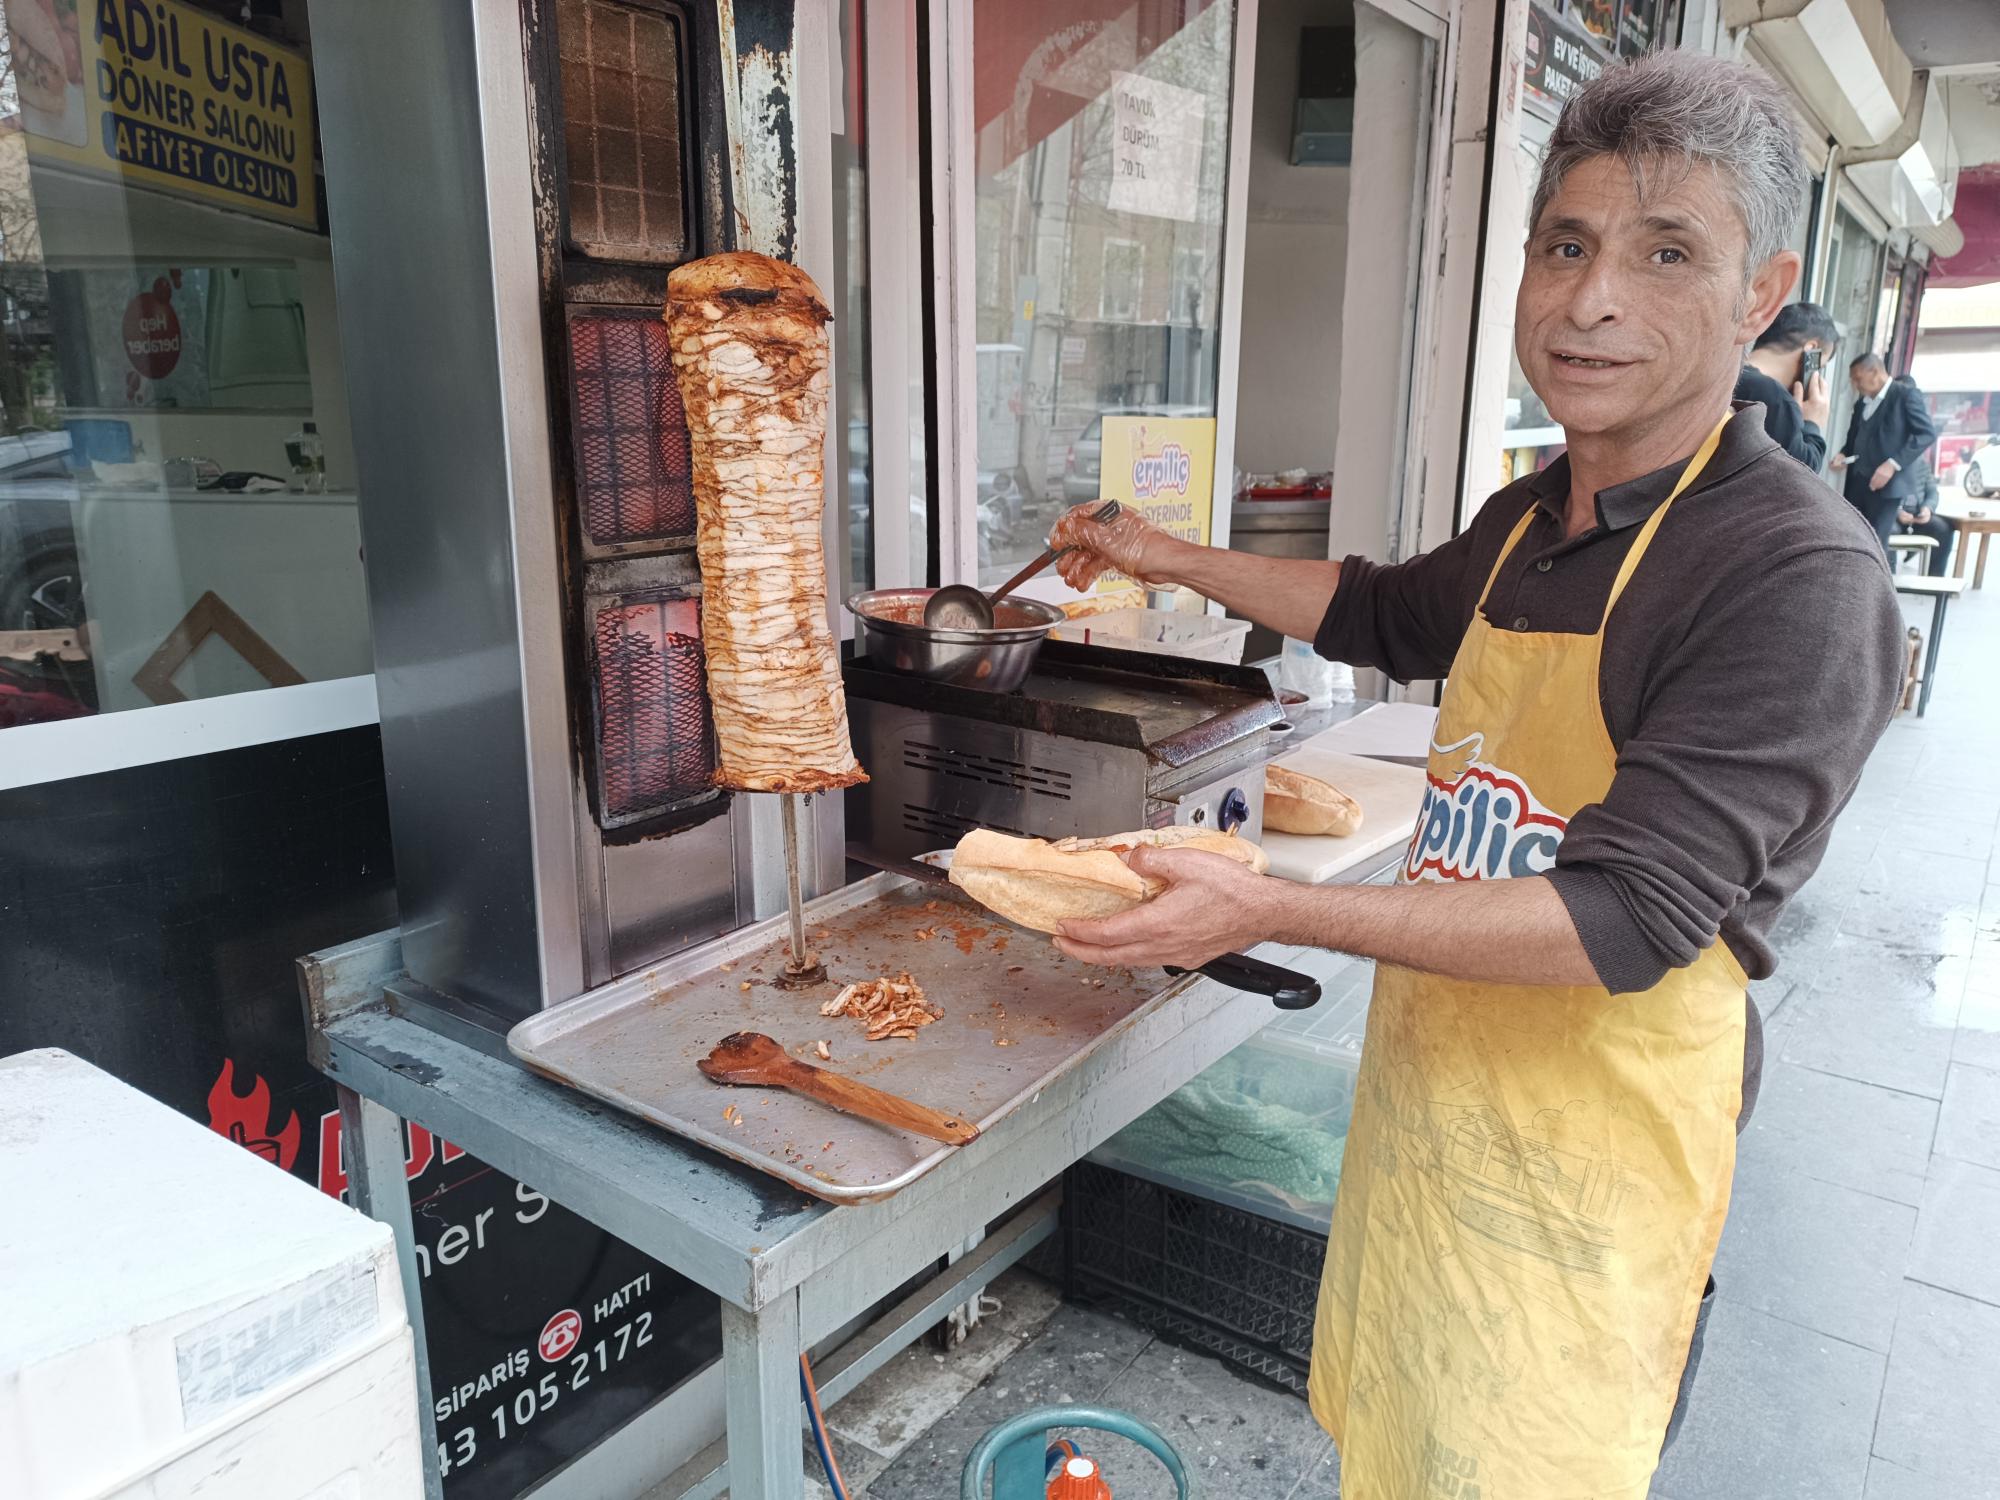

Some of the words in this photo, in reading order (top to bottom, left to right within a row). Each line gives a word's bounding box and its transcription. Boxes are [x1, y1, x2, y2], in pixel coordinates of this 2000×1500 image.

[203, 28, 292, 118] USTA
[1554, 35, 1567, 61] EV
[1567, 43, 1579, 70] VE
[96, 56, 195, 130] DÖNER
[203, 98, 295, 163] SALONU
[213, 152, 291, 203] OLSUN
[1121, 158, 1134, 176] 70
[1135, 161, 1147, 179] TL
[1134, 449, 1189, 492] erpiliç
[593, 1272, 651, 1324] HATTI
[491, 1372, 559, 1440] 105
[570, 1311, 653, 1391] 2172
